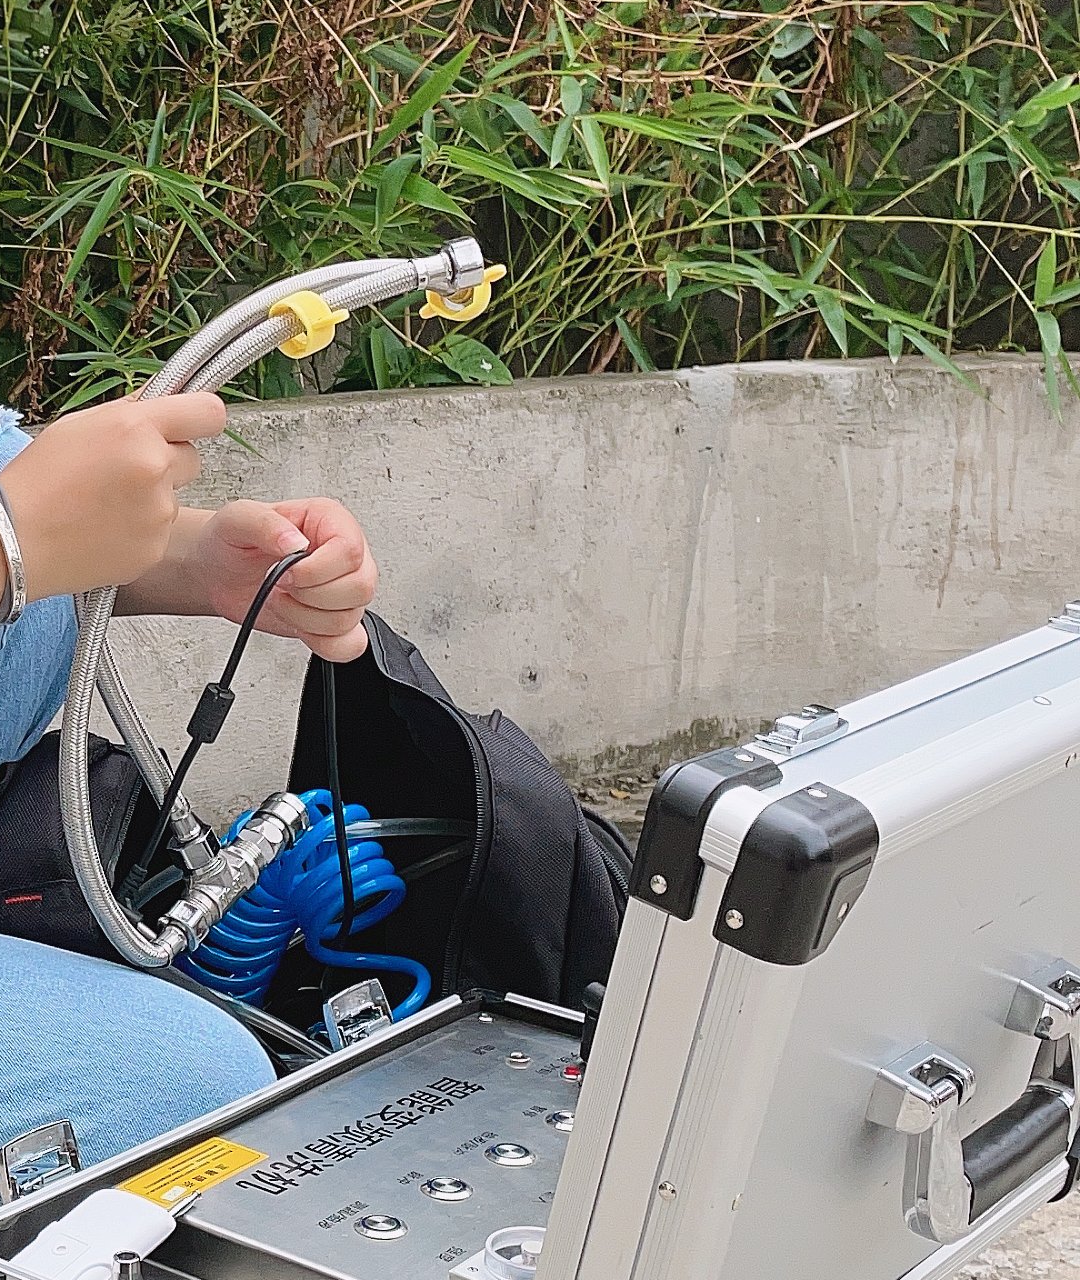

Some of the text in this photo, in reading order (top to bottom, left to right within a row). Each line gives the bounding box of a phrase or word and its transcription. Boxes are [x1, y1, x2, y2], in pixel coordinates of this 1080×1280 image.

[236, 1077, 486, 1195] 智能变频清洗机
